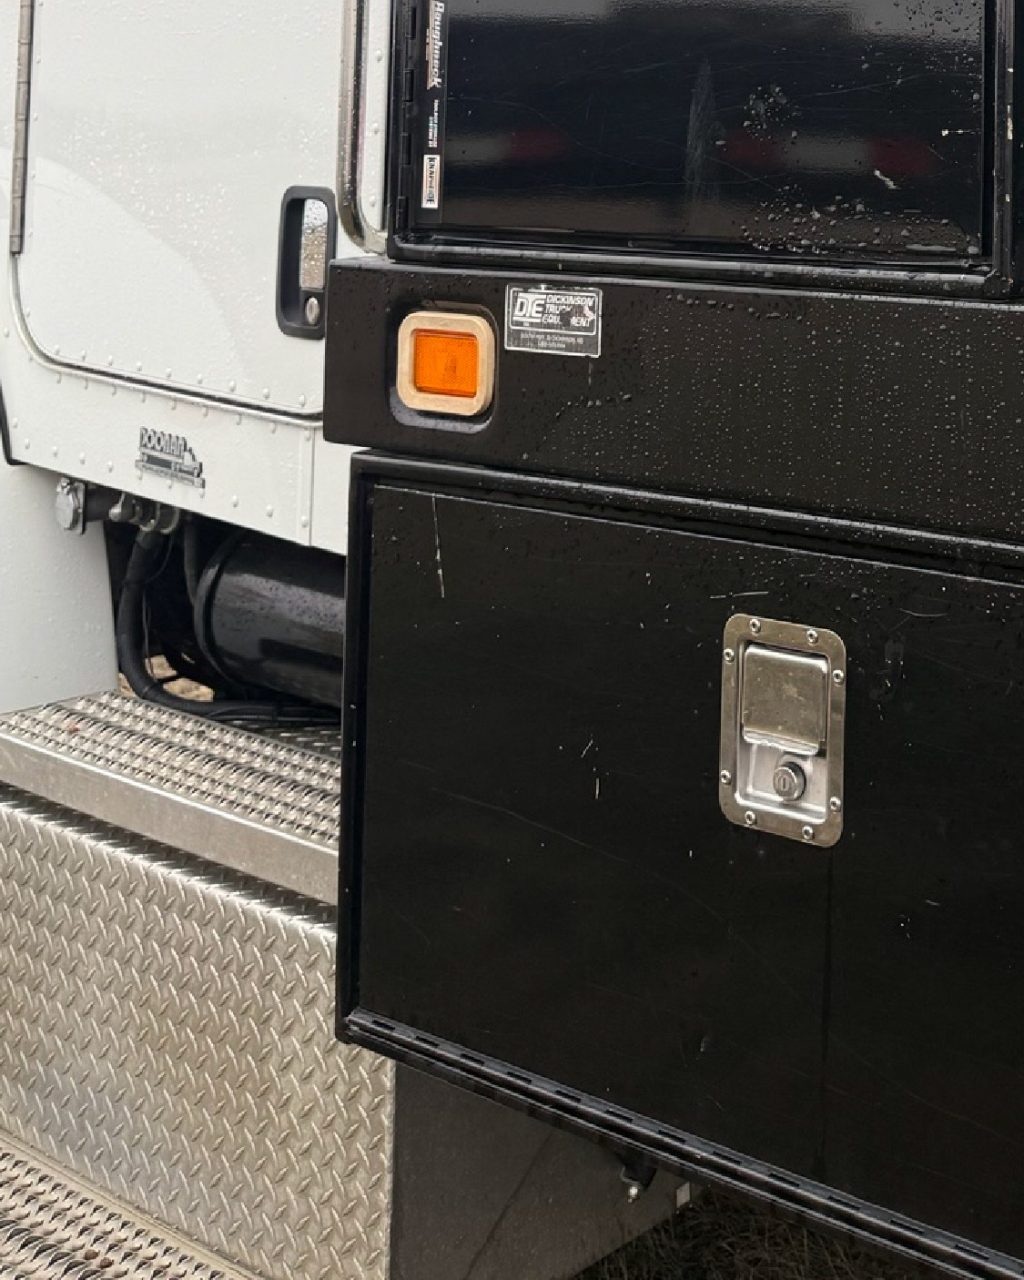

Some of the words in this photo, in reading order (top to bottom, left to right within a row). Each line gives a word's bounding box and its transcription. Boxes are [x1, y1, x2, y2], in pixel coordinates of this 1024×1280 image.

[514, 293, 546, 317] DTE
[546, 295, 595, 306] DICKINSON
[541, 314, 590, 327] EQUMENT
